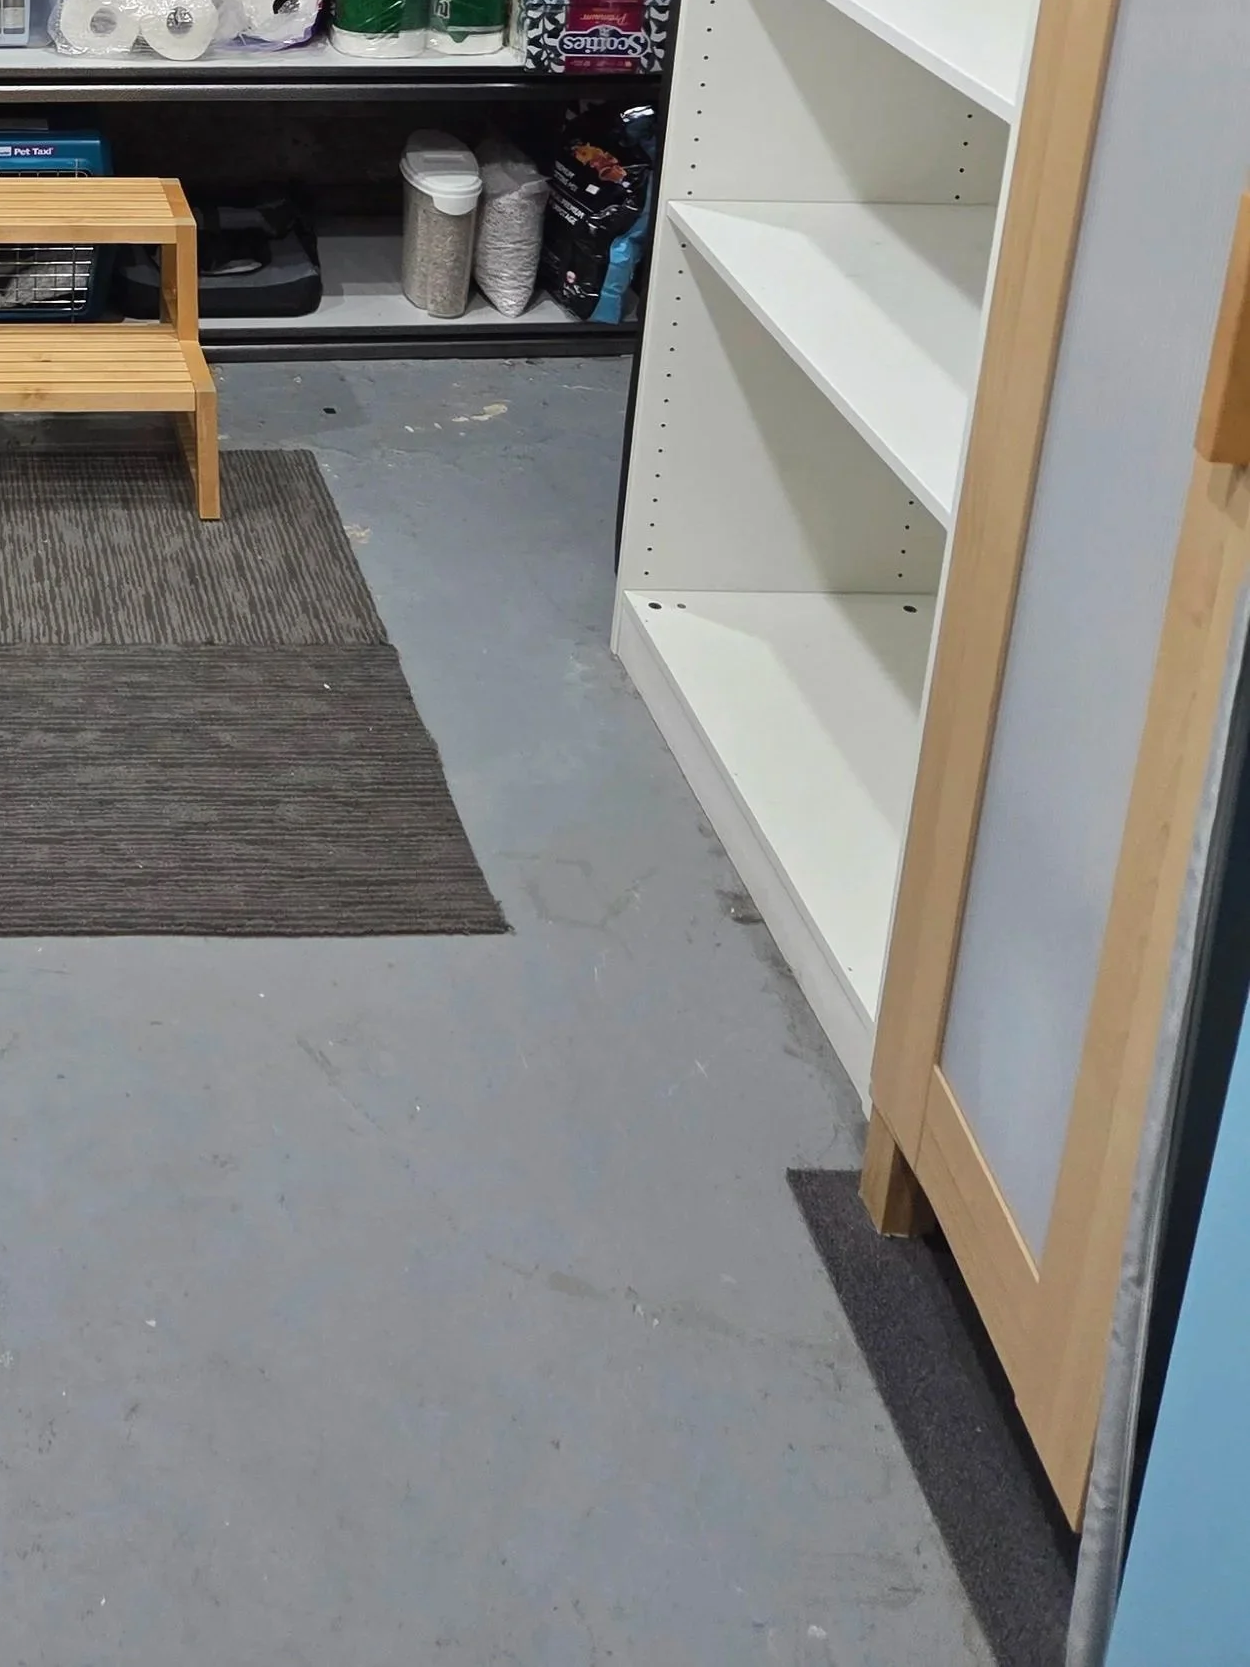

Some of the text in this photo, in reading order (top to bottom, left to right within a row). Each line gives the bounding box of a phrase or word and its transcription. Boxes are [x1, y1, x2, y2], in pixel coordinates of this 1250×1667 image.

[580, 13, 628, 27] Premium
[563, 35, 645, 56] Scotties
[14, 148, 30, 156] Pet
[32, 147, 52, 155] Taxi
